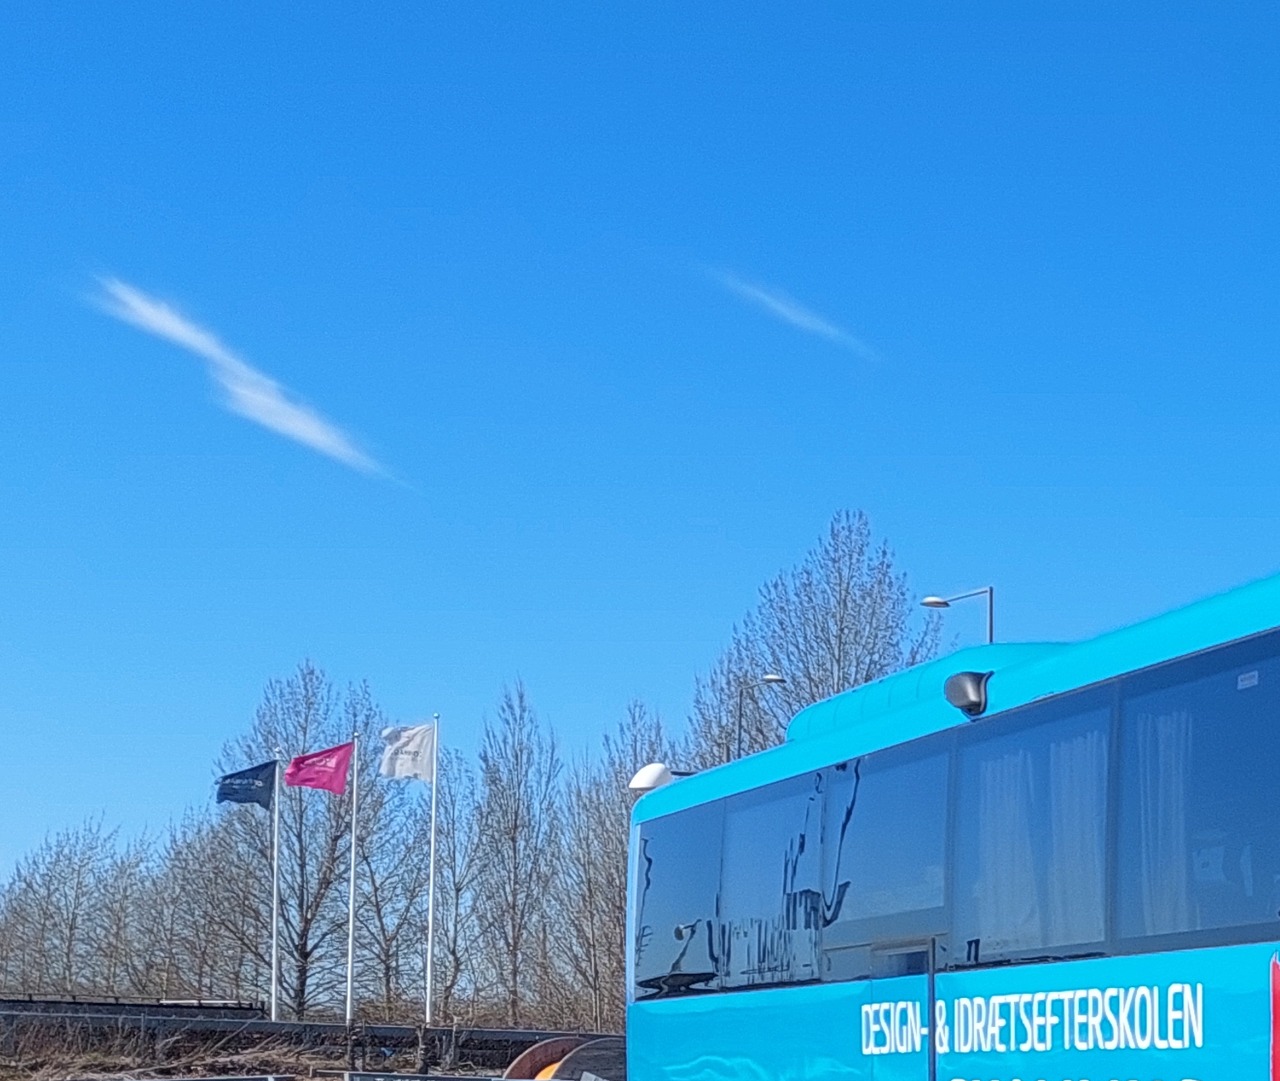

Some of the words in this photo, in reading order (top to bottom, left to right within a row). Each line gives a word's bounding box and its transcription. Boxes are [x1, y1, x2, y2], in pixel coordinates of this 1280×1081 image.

[862, 1001, 929, 1054] DESIGN-
[935, 1000, 950, 1053] &
[954, 984, 1204, 1053] IDRÆTSEFTERSKOLEN
